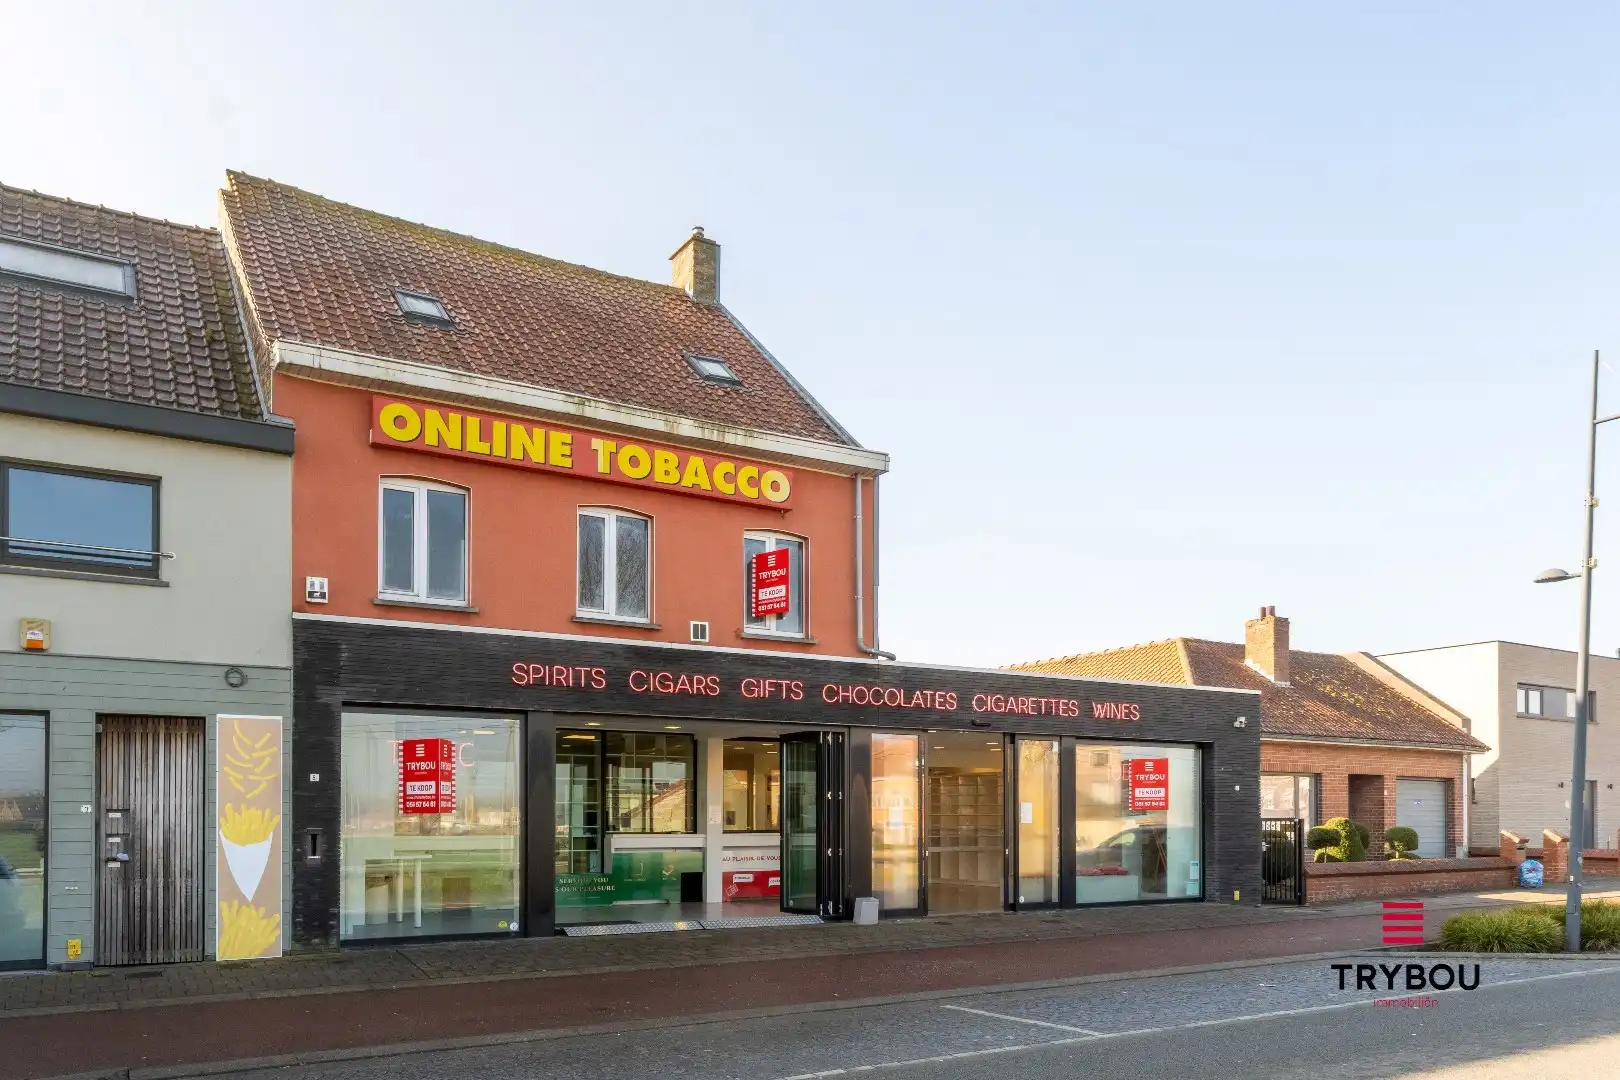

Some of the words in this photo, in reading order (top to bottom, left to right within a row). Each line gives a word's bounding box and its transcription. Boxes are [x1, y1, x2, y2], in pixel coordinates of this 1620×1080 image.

[379, 402, 574, 468] ONLINE
[591, 437, 792, 503] TOBACCO
[759, 568, 786, 579] TRYBOU
[511, 662, 607, 690] SPIRITS
[628, 670, 721, 696] CIGARS
[741, 678, 804, 701] GIFTS
[822, 683, 958, 711] CHOCOLATES
[972, 694, 1079, 718] CIGARETTES
[1091, 701, 1140, 721] WINES
[406, 761, 436, 771] TRYBOU
[1134, 773, 1166, 781] TRYBOU
[410, 784, 416, 792] TE
[417, 784, 433, 792] KOOP
